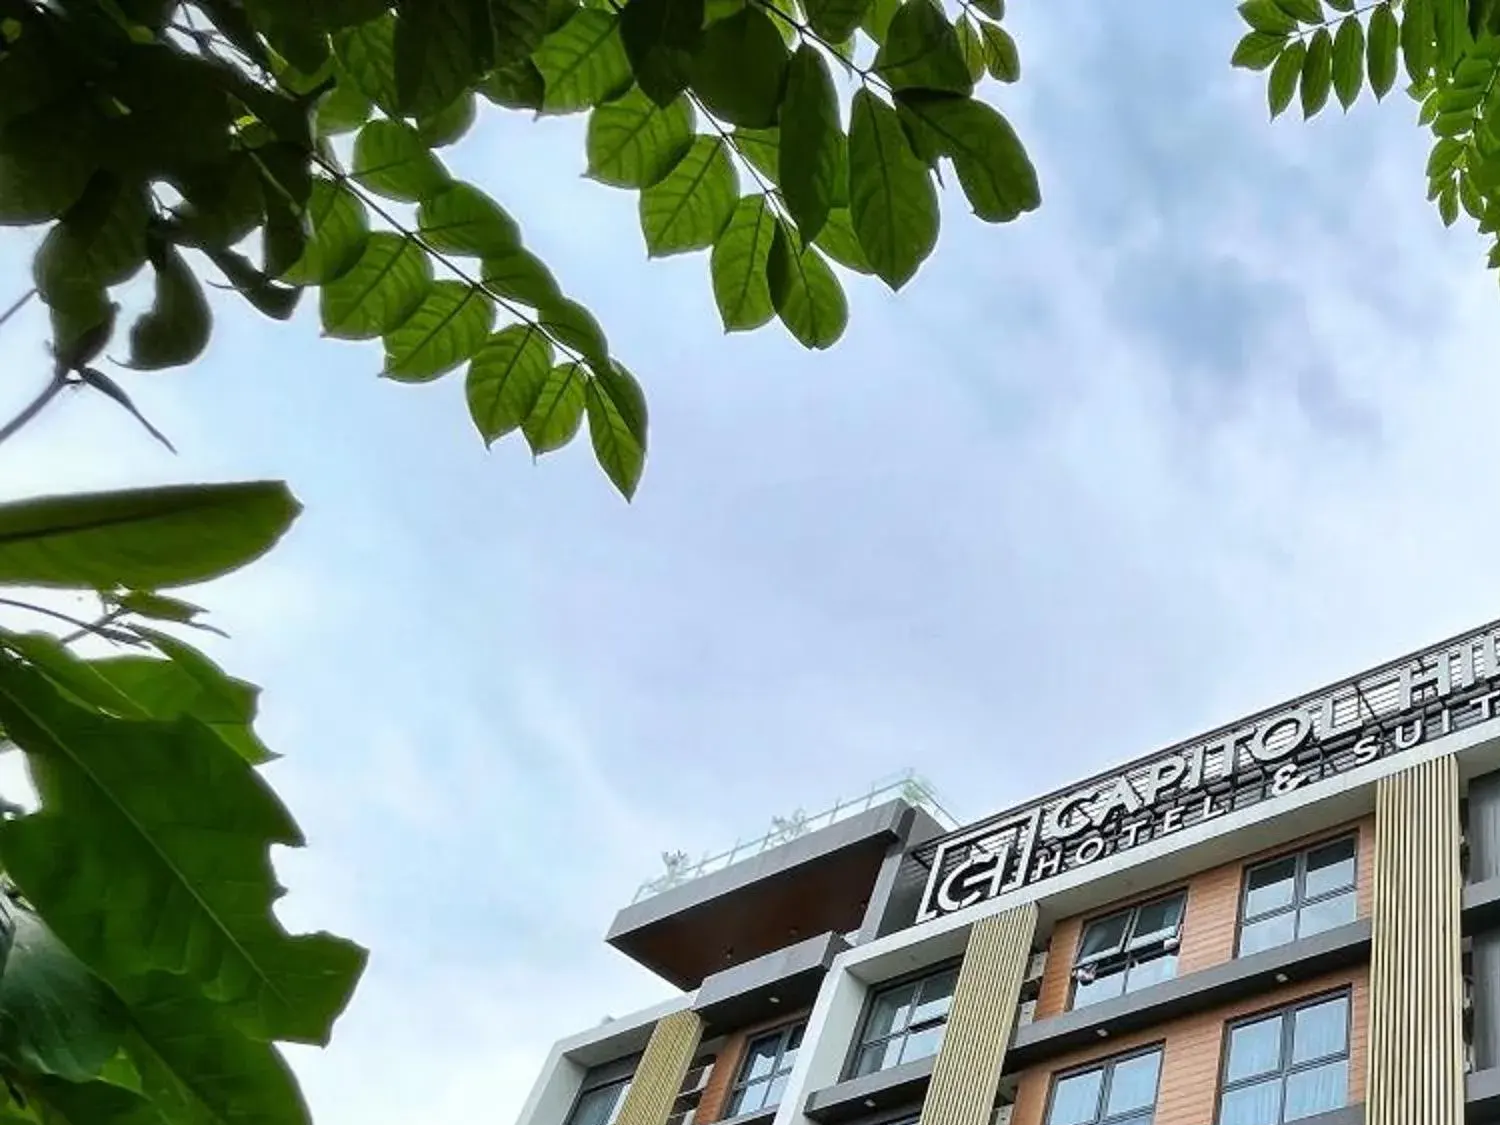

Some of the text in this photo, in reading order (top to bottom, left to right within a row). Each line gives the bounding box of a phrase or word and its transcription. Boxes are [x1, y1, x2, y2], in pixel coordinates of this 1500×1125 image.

[1033, 795, 1226, 880] HOTEL
[1270, 762, 1302, 798] &
[1051, 697, 1366, 840] CAPITOL
